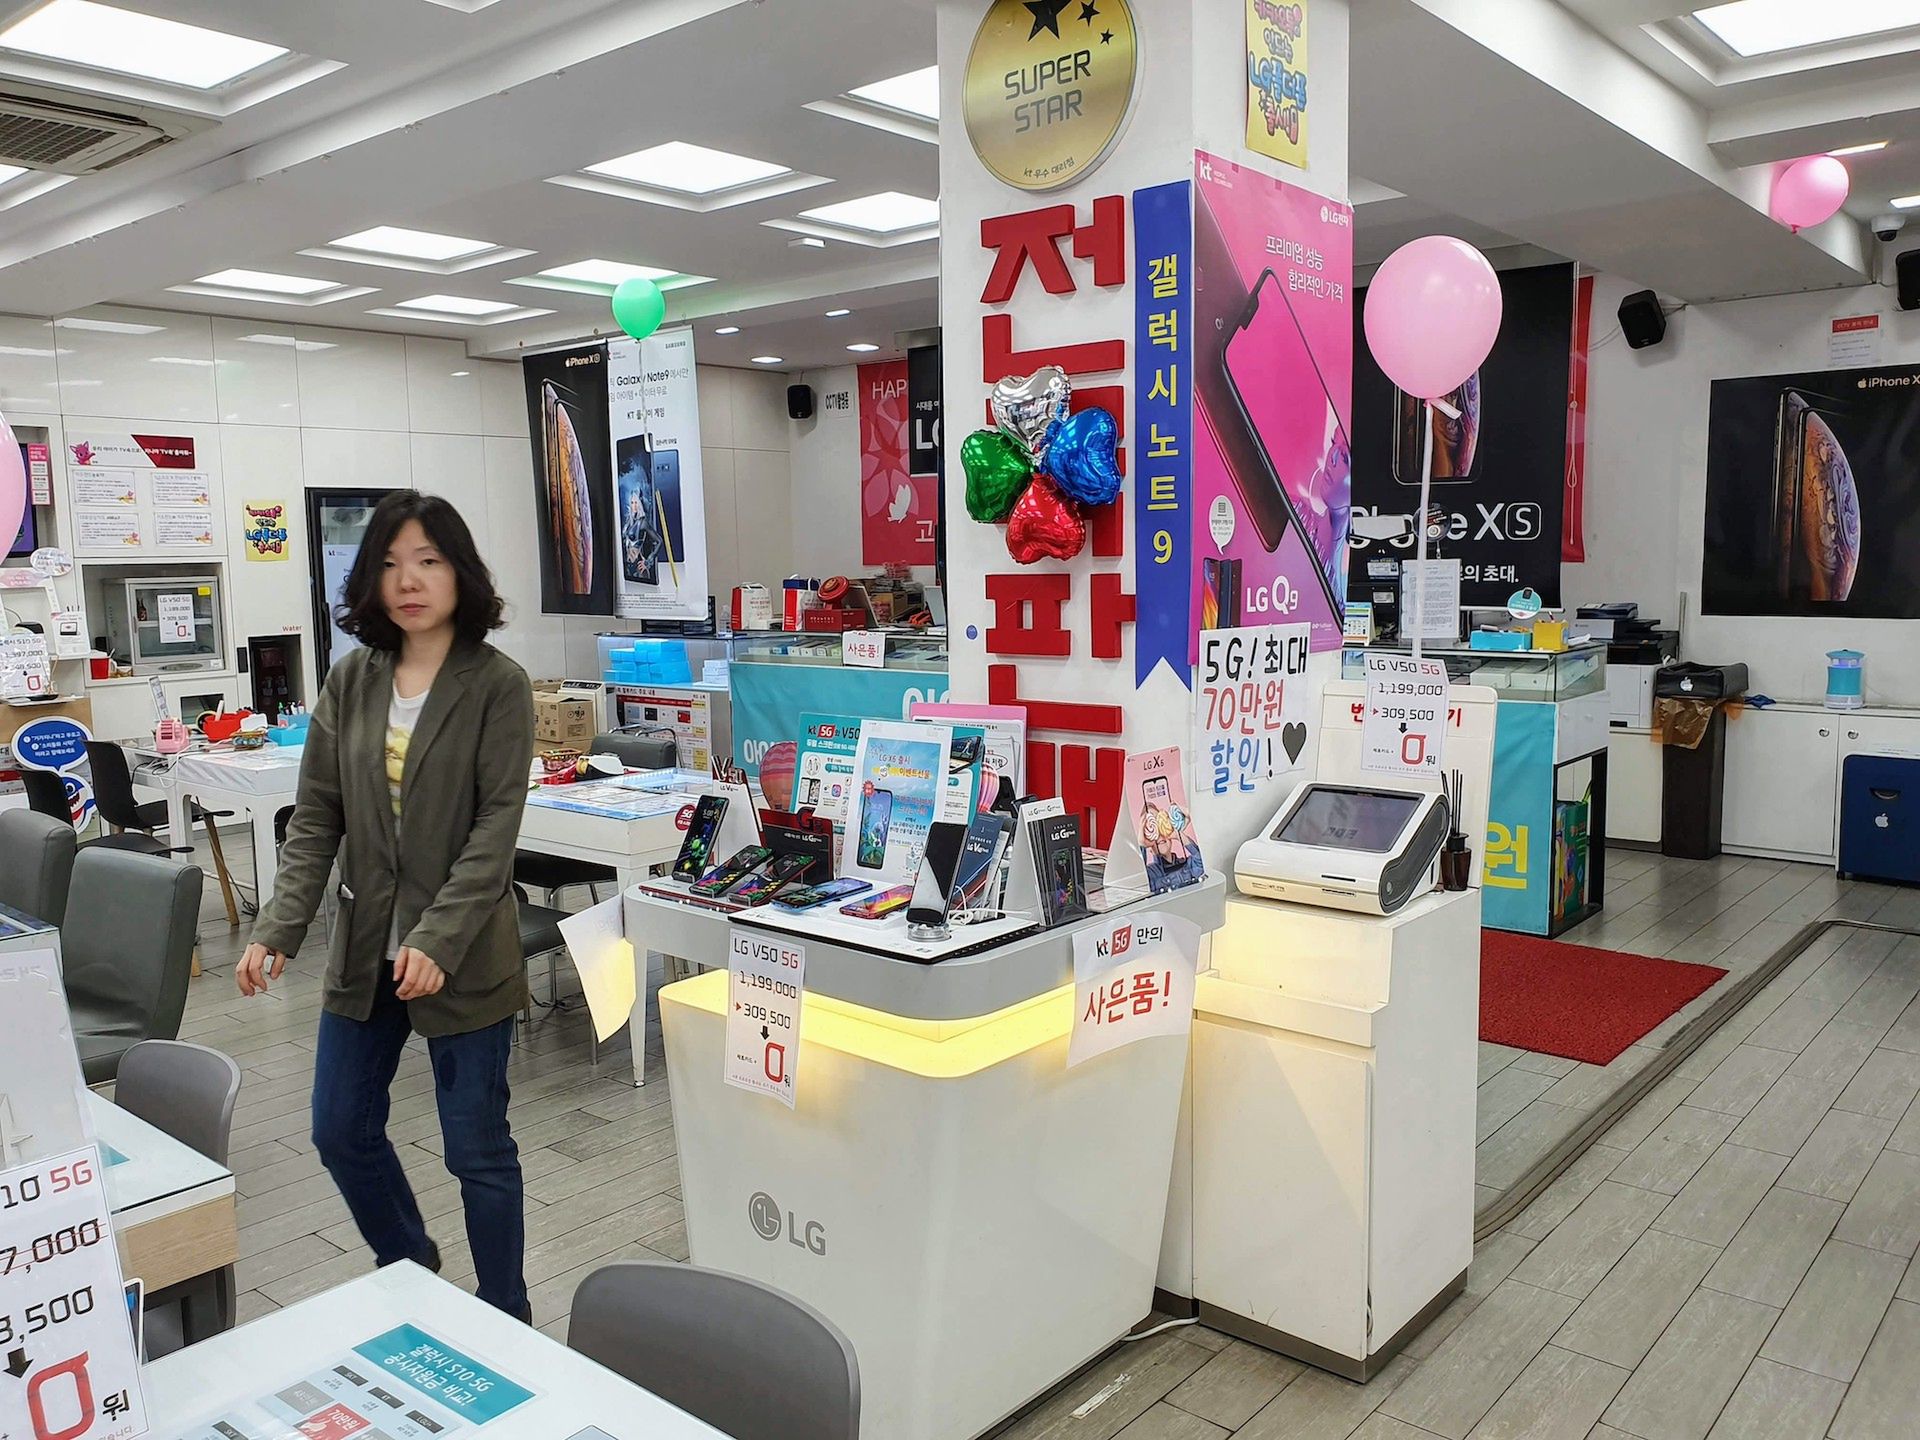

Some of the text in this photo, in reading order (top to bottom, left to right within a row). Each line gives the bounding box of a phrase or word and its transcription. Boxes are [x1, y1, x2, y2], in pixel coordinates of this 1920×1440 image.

[1004, 49, 1092, 100] SUPER
[1014, 89, 1083, 133] STAR
[1200, 160, 1212, 181] kt
[1329, 210, 1349, 227] LG전자
[1265, 235, 1324, 271] 프리미엄 성능
[1288, 268, 1344, 304] 합리적인 가격
[570, 356, 590, 367] iPhone
[616, 373, 646, 387] Galaxy
[1868, 374, 1910, 389] iPhone
[627, 411, 635, 420] KT
[636, 409, 653, 421] 플이
[1147, 252, 1181, 565] 갤럭시노트9
[1483, 564, 1519, 583] 초대.
[1246, 575, 1299, 615] LG Q9
[282, 624, 303, 633] Water
[848, 642, 879, 659] 사은품!
[1264, 633, 1308, 676] 최대
[1369, 659, 1440, 676] LG V50 5G
[1379, 682, 1443, 697] 1,199,000
[1203, 678, 1285, 736] 70만원
[1381, 707, 1435, 722] 309,500
[808, 725, 816, 735] kt
[820, 726, 833, 737] 5G
[879, 754, 887, 762] LG
[1401, 734, 1427, 766] 0
[711, 755, 745, 784] V50
[1143, 760, 1153, 771] LG
[1210, 737, 1274, 795] 할인!
[1051, 832, 1060, 841] LG
[734, 937, 799, 970] LG V50 5G
[1096, 926, 1163, 957] kt 5G 만의
[739, 970, 797, 1000] 1,199,000
[1083, 970, 1171, 1025] 사은품!
[743, 1002, 792, 1030] 309,500
[764, 1041, 786, 1084] 0
[50, 1159, 92, 1194] 5G
[788, 1210, 826, 1256] LG
[383, 1352, 477, 1406] 공시지원금 비교!
[409, 1342, 495, 1392] 갤럭시 S10 5G
[27, 1350, 96, 1440] 0
[328, 1408, 361, 1431] 70만원
